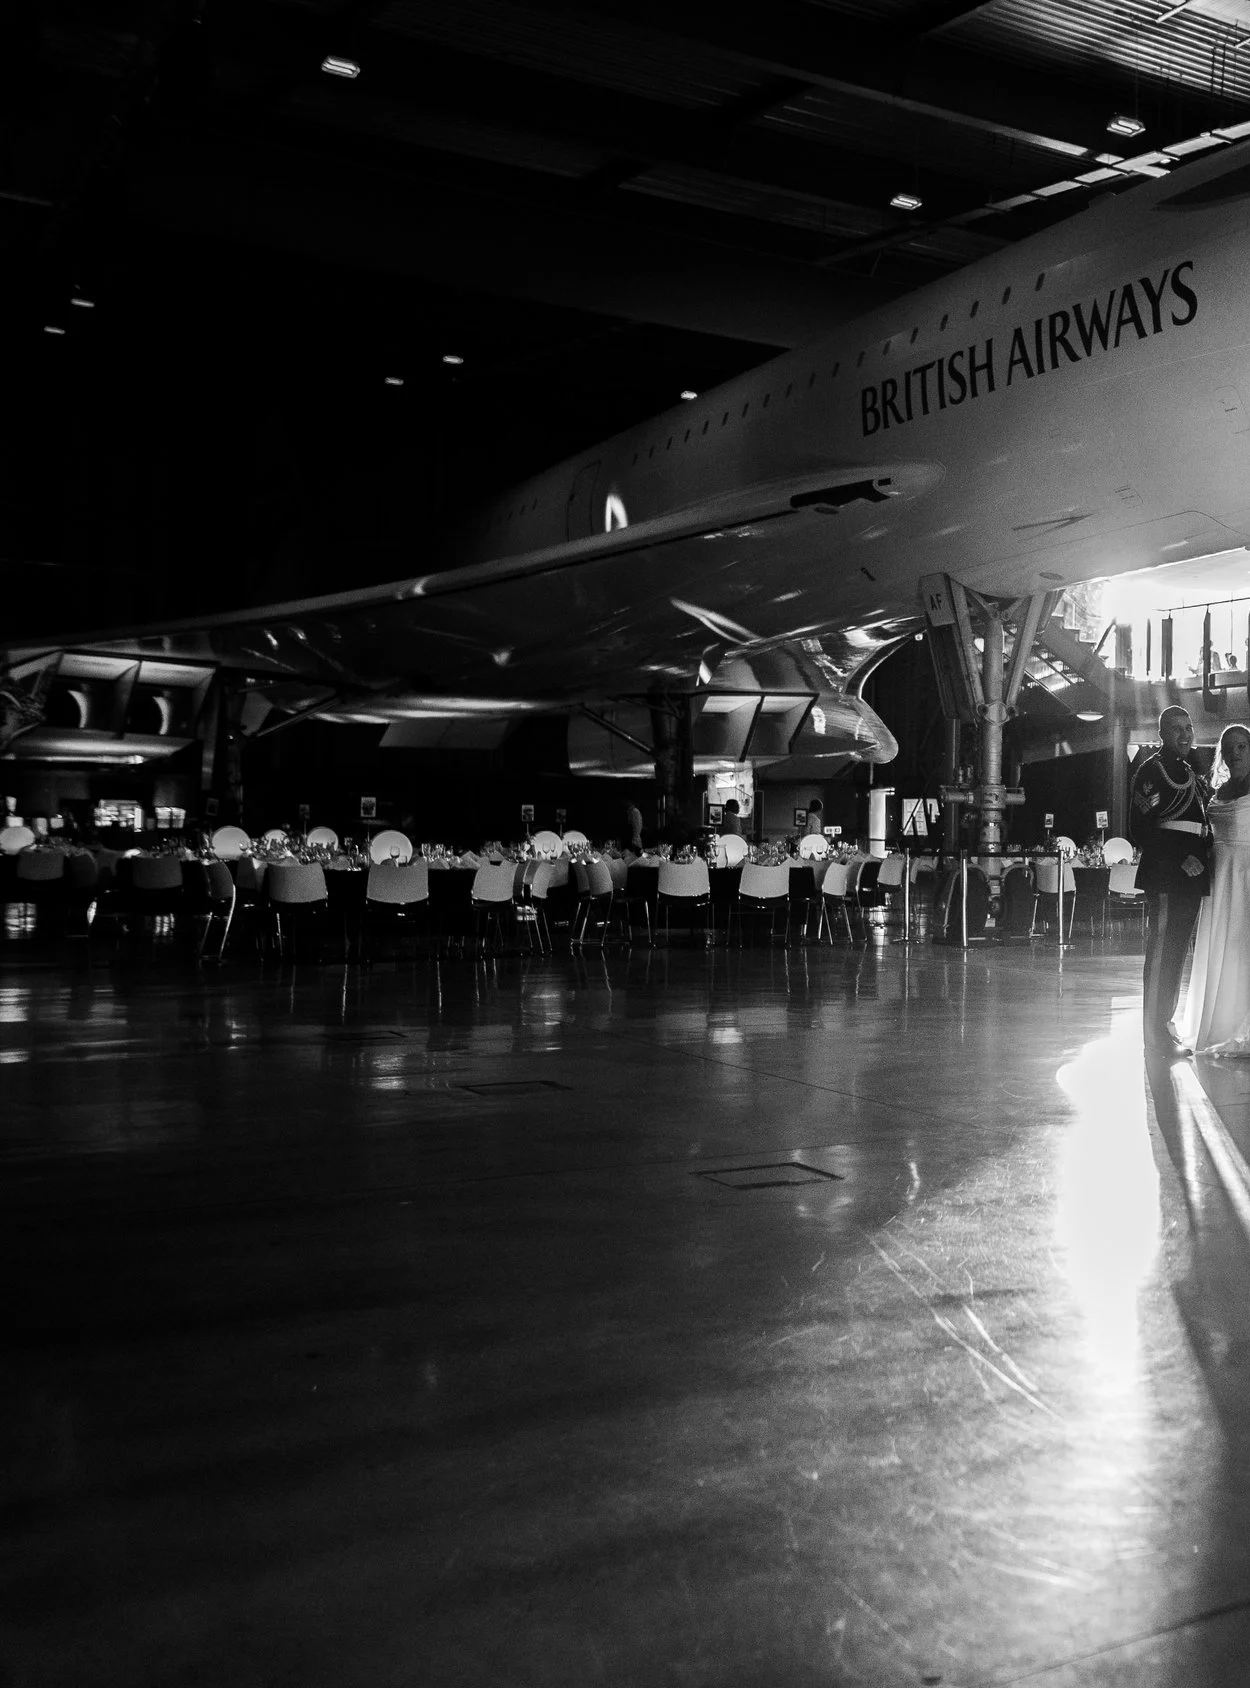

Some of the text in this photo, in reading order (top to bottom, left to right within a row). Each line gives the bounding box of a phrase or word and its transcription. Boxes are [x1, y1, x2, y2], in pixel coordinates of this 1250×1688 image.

[861, 260, 1199, 437] BRITISH AIRWAYS
[930, 594, 942, 610] AF
